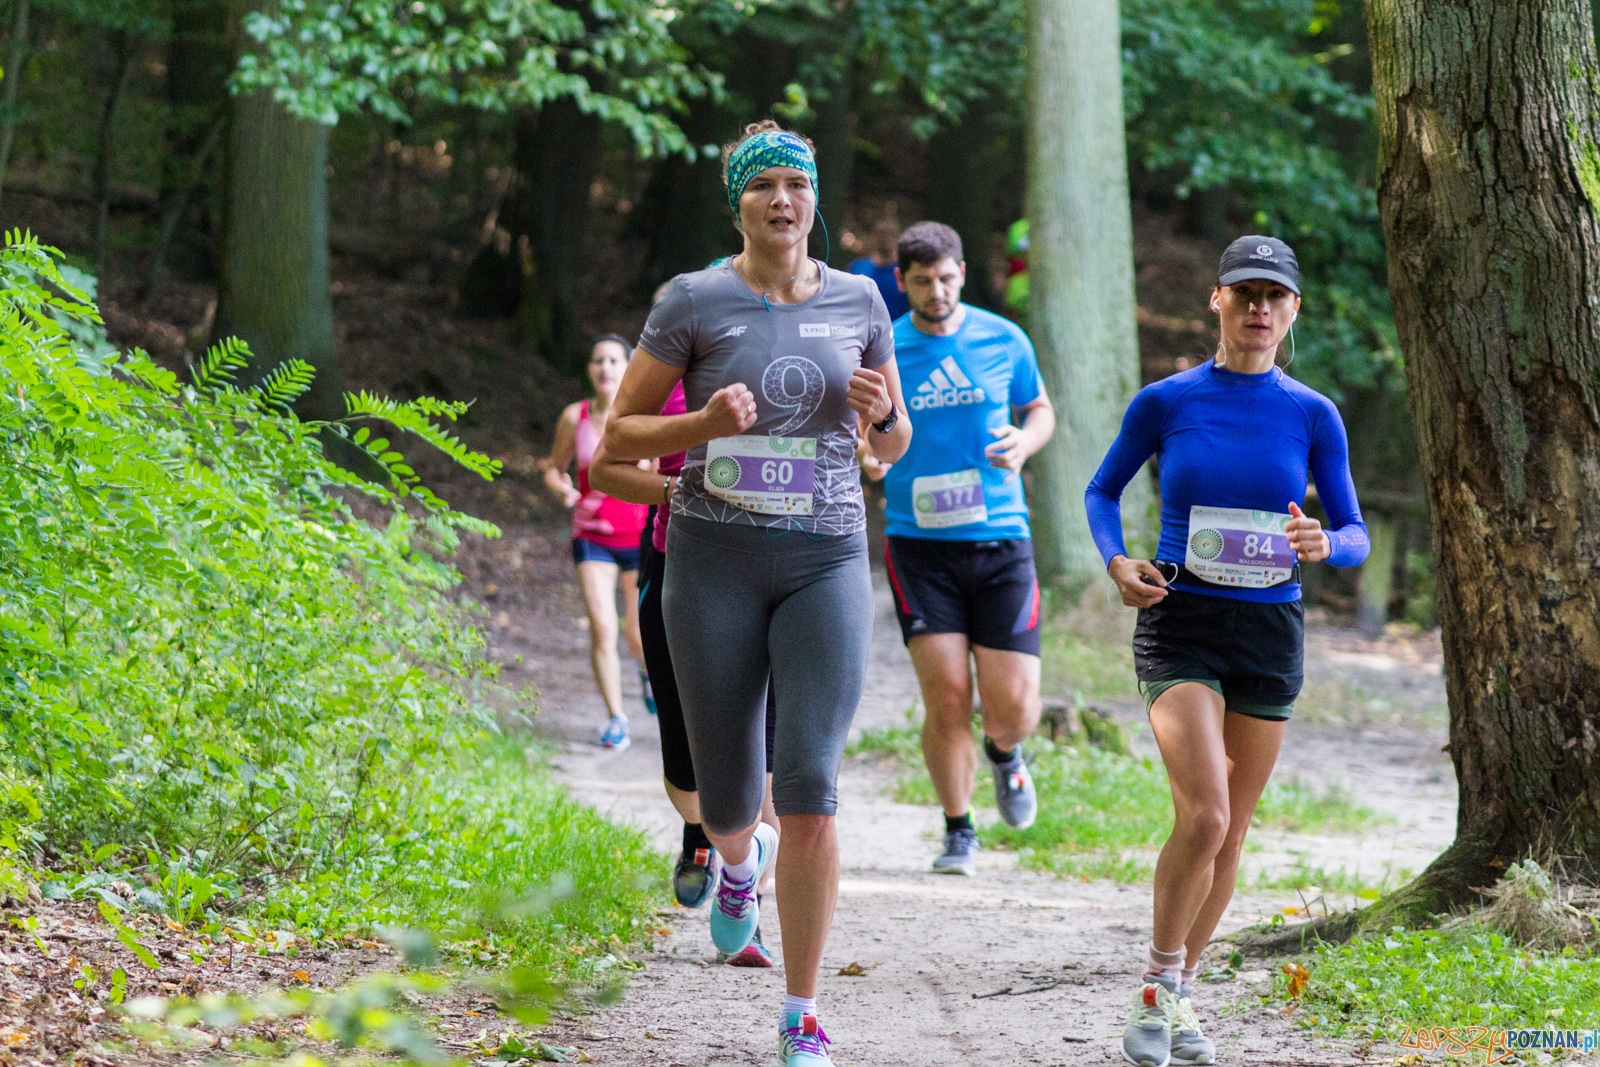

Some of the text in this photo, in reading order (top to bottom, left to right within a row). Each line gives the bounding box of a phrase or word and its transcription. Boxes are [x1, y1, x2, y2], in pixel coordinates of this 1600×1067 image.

[761, 355, 826, 437] 9
[909, 387, 986, 411] adidas
[761, 460, 794, 485] 60
[1243, 533, 1275, 559] 84
